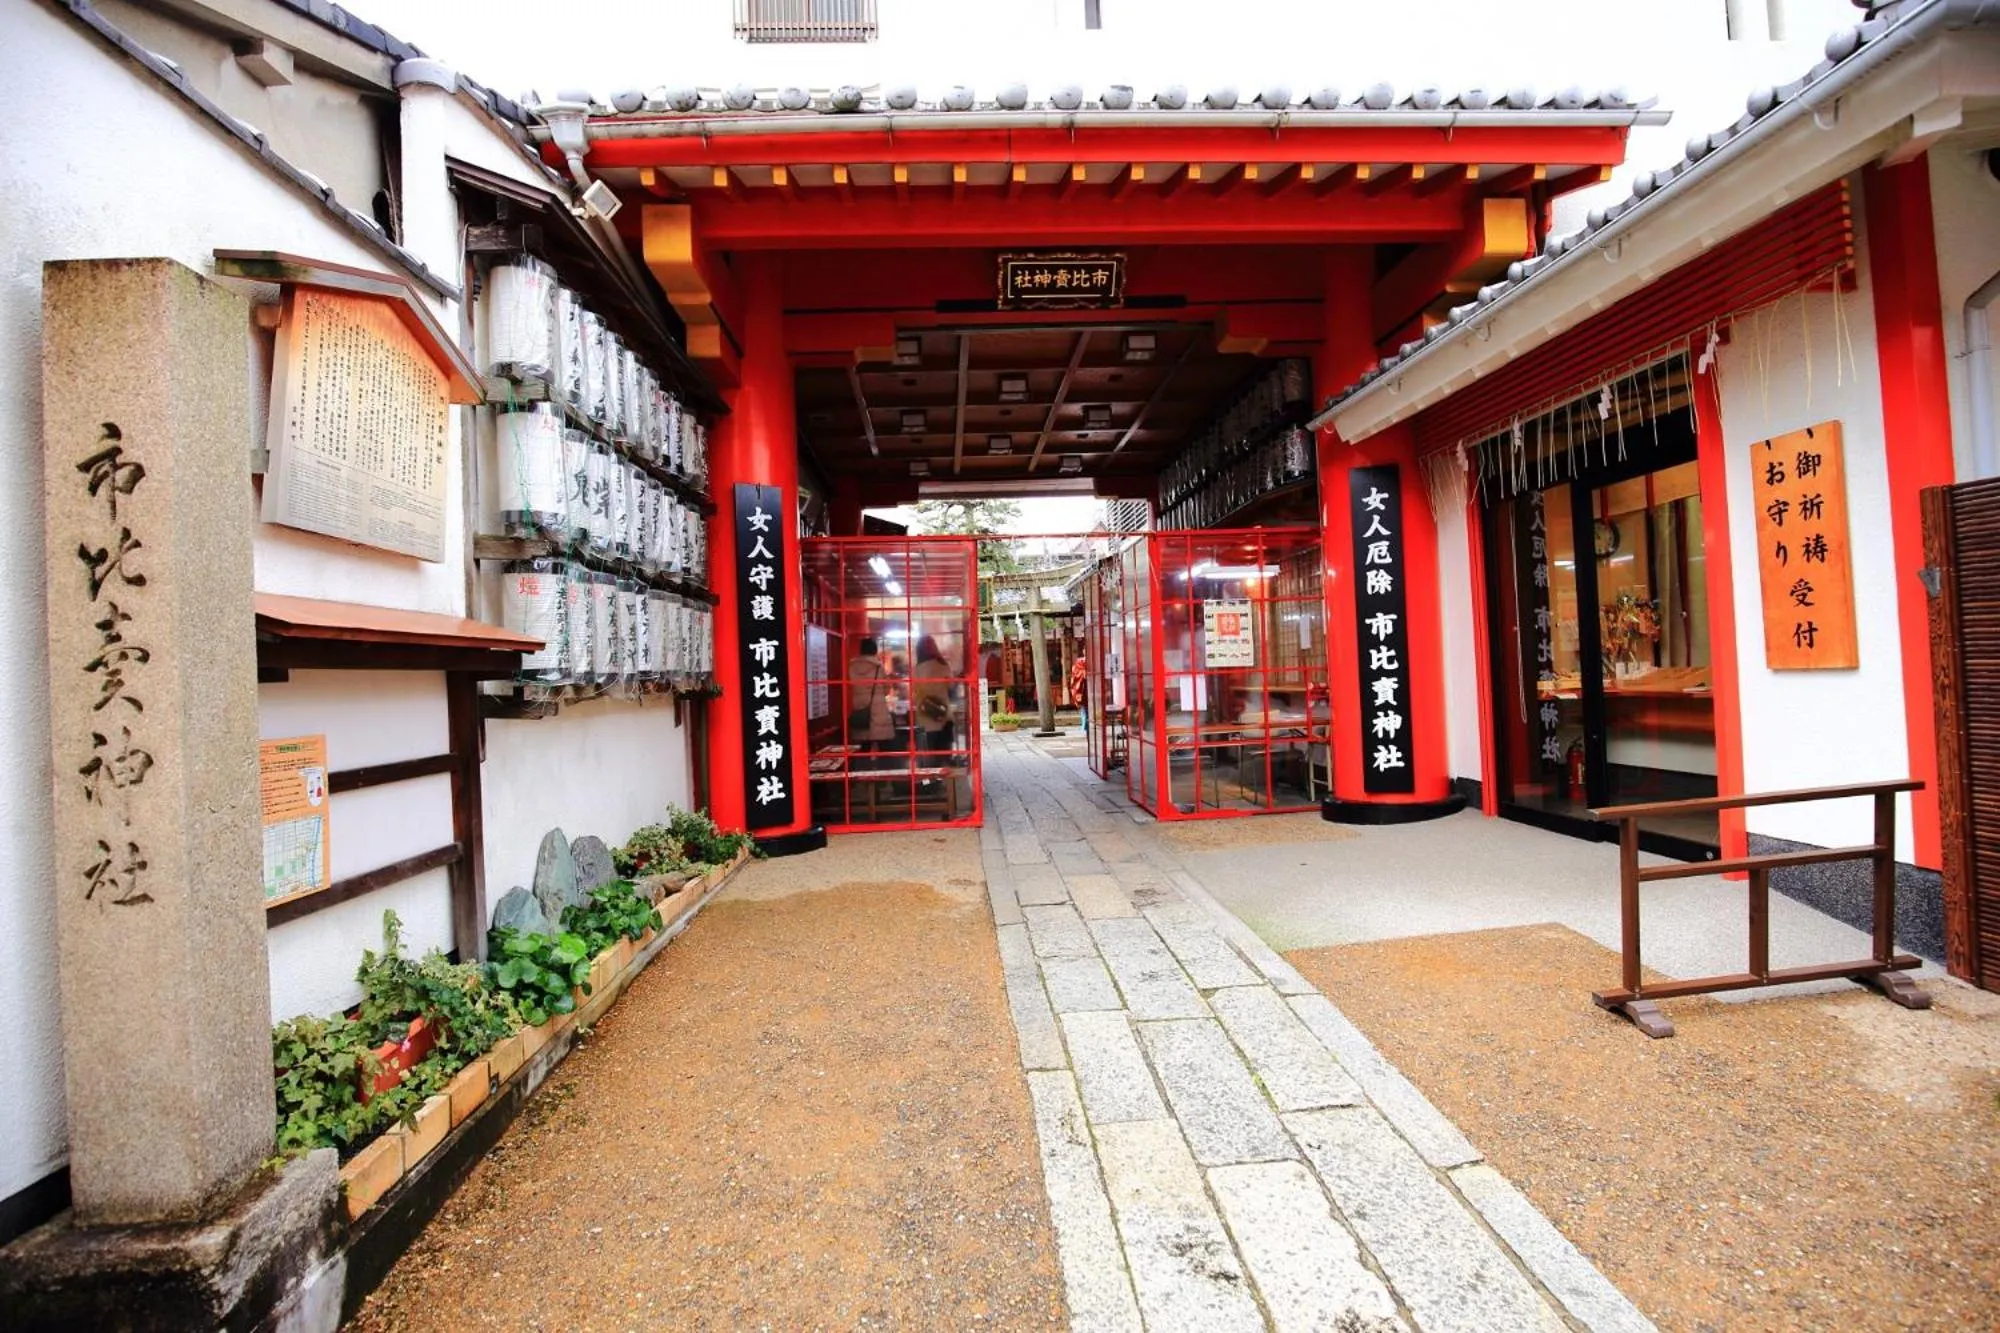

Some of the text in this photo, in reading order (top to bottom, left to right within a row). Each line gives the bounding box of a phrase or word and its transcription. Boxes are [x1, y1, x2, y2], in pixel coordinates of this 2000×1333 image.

[1766, 461, 1790, 567] お守り
[1795, 452, 1828, 564] 御祈祷
[746, 506, 786, 806] 女人守護 市比賣神社
[1362, 487, 1405, 772] 女人厄除 市比賣神社
[1789, 578, 1818, 649] 受付
